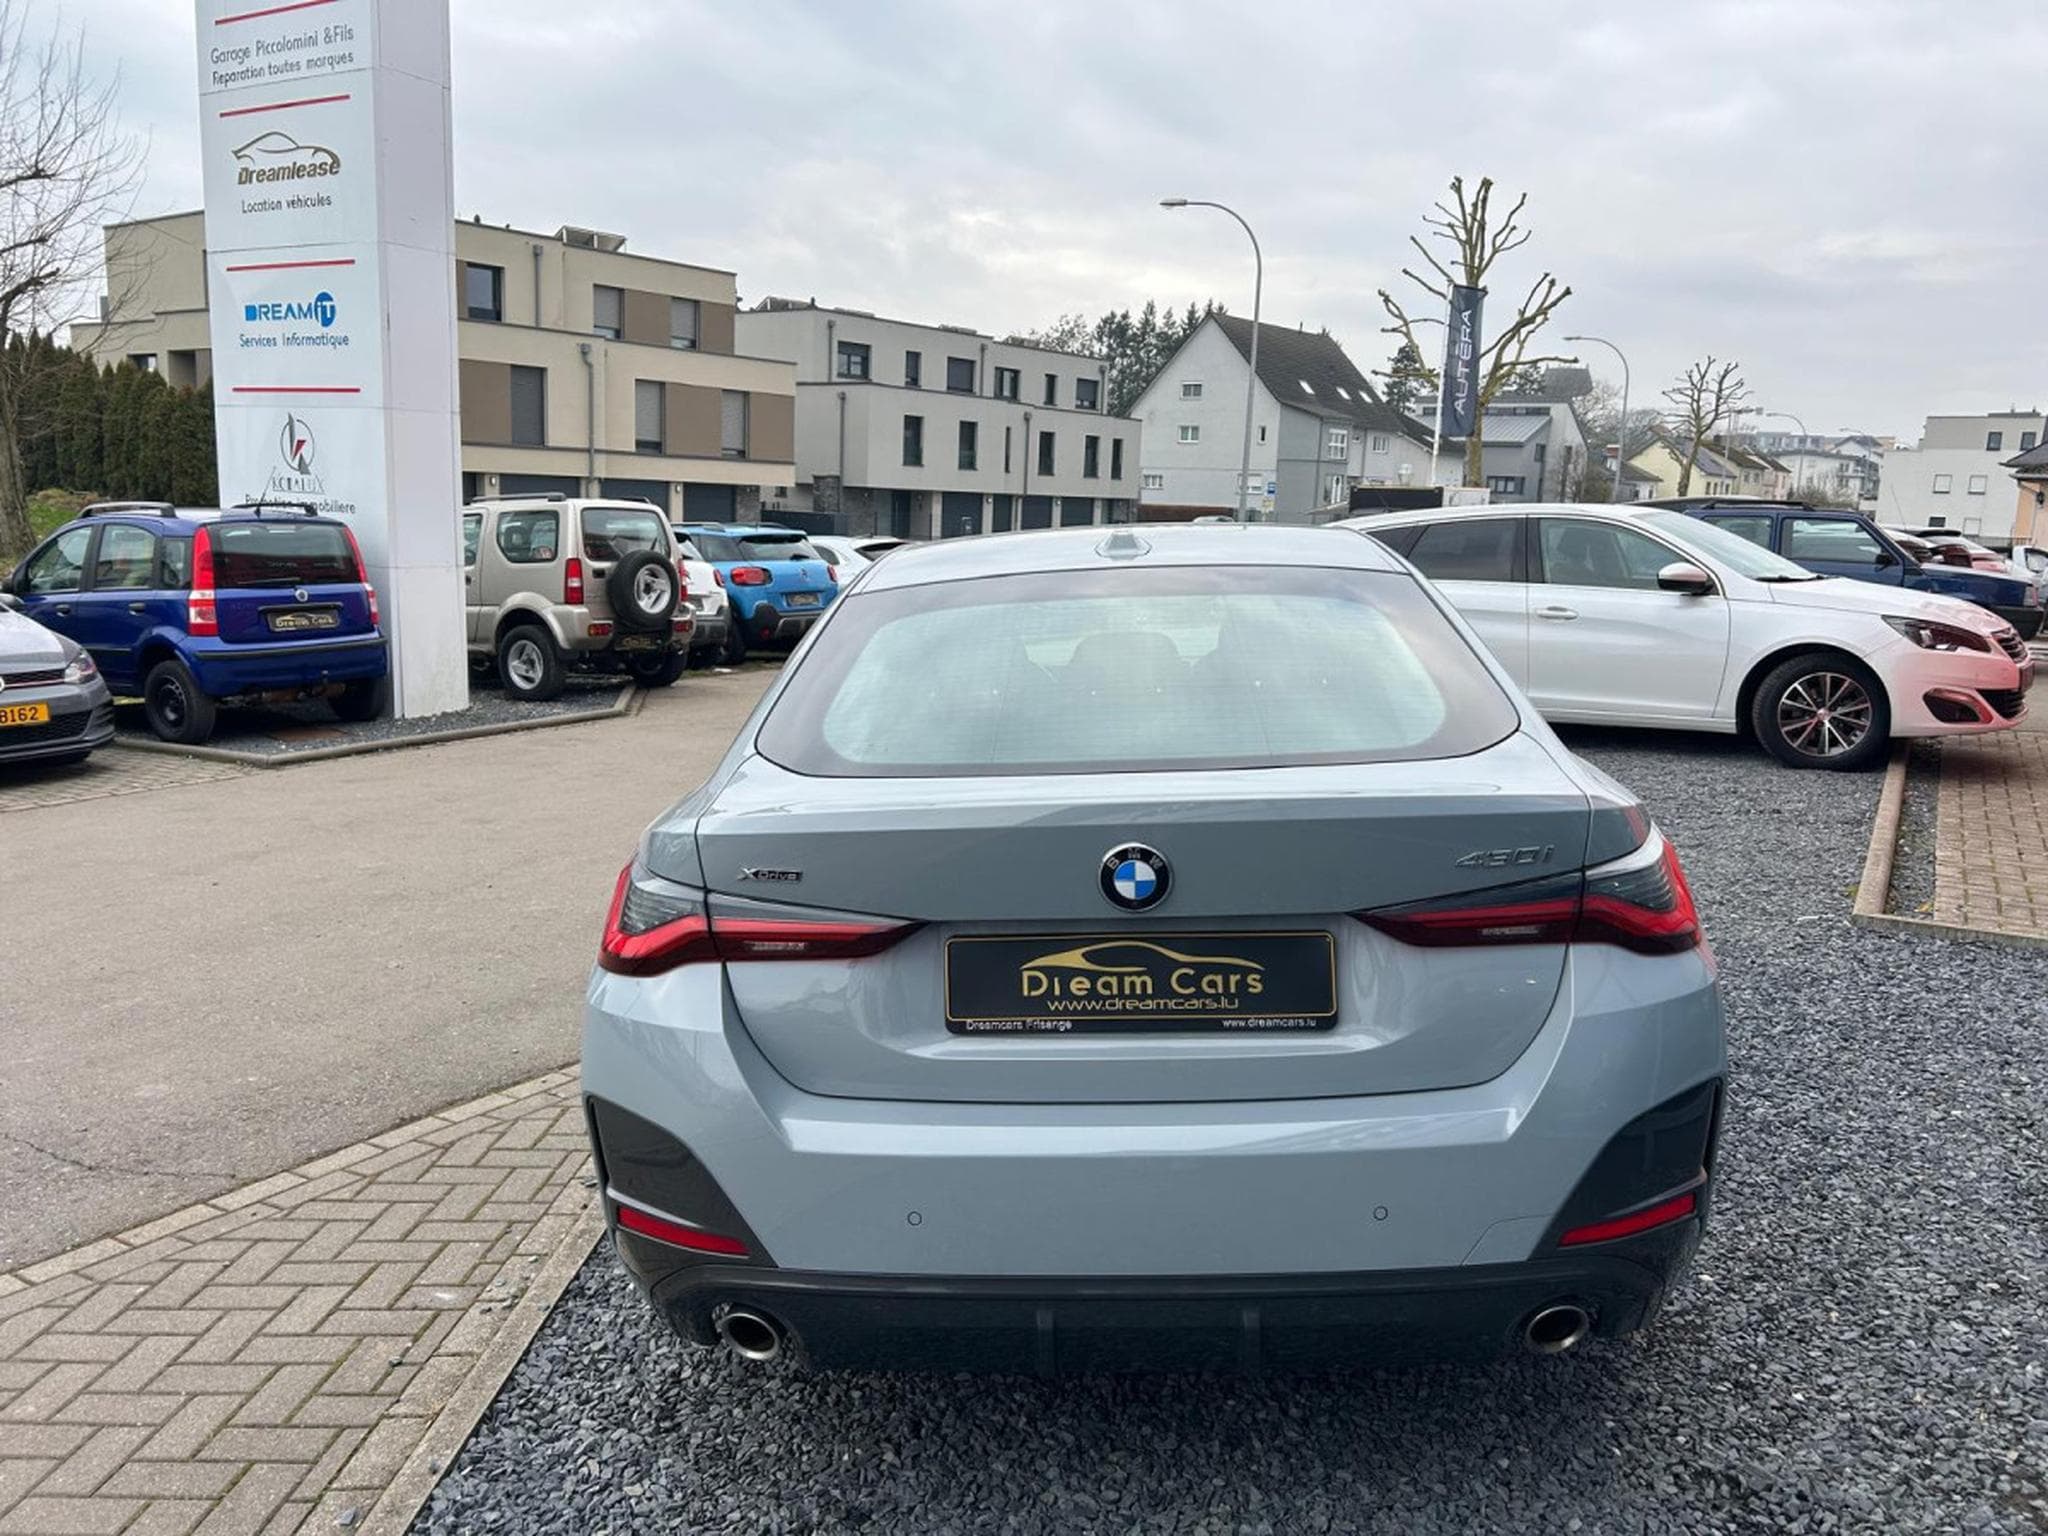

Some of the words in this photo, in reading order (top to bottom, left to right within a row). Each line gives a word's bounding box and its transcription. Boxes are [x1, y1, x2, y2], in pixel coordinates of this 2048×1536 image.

[211, 46, 251, 65] Garage
[255, 31, 318, 57] Piccolomini
[323, 24, 354, 45] &Fils
[212, 66, 265, 87] Reparation
[268, 61, 301, 76] toutes
[306, 52, 354, 71] marques
[238, 160, 341, 185] Dreamlease
[241, 198, 283, 214] Location
[239, 333, 278, 348] Services
[282, 332, 350, 350] Informatique
[1455, 844, 1554, 867] 430i
[1170, 967, 1264, 995] Cars
[1047, 996, 1240, 1012] www.dreamcars.lu
[965, 1019, 1024, 1031] Dreamcars
[1025, 1018, 1073, 1032] Frisange
[1221, 1017, 1317, 1028] www.dreamcars.lu
